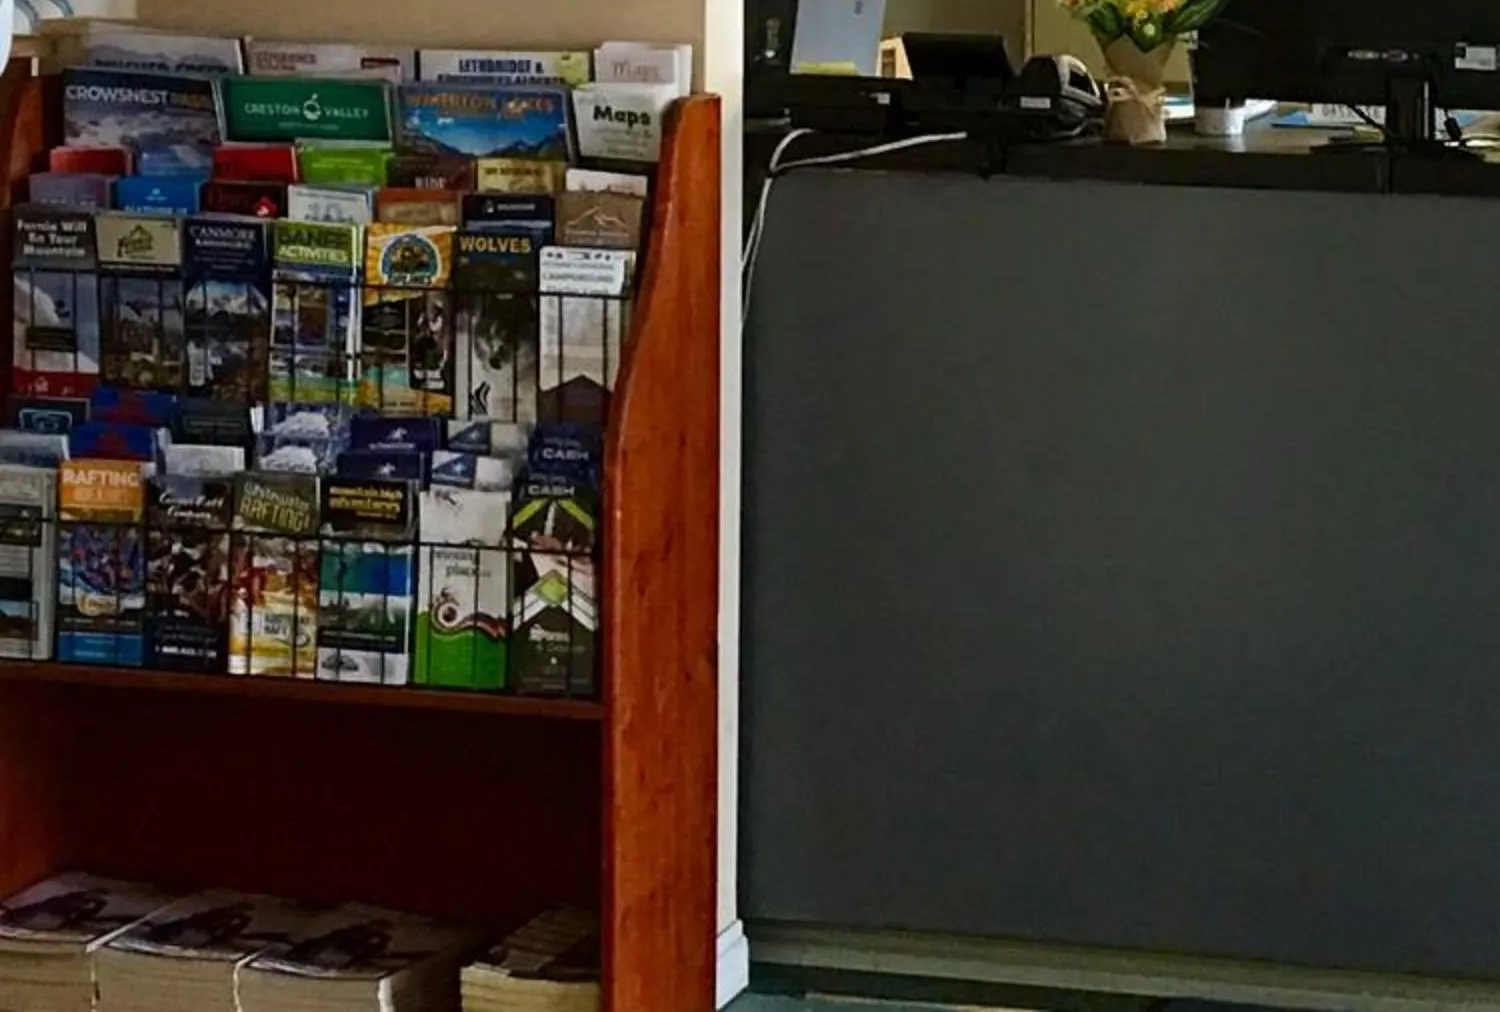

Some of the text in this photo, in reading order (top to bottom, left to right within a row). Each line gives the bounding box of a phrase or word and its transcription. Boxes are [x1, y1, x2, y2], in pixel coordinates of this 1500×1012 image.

[65, 84, 170, 106] CROWSNEST
[244, 102, 369, 120] CRESTON VALLEY
[592, 105, 651, 129] Maps
[459, 234, 532, 255] WOLVES
[62, 468, 139, 489] RAFTING
